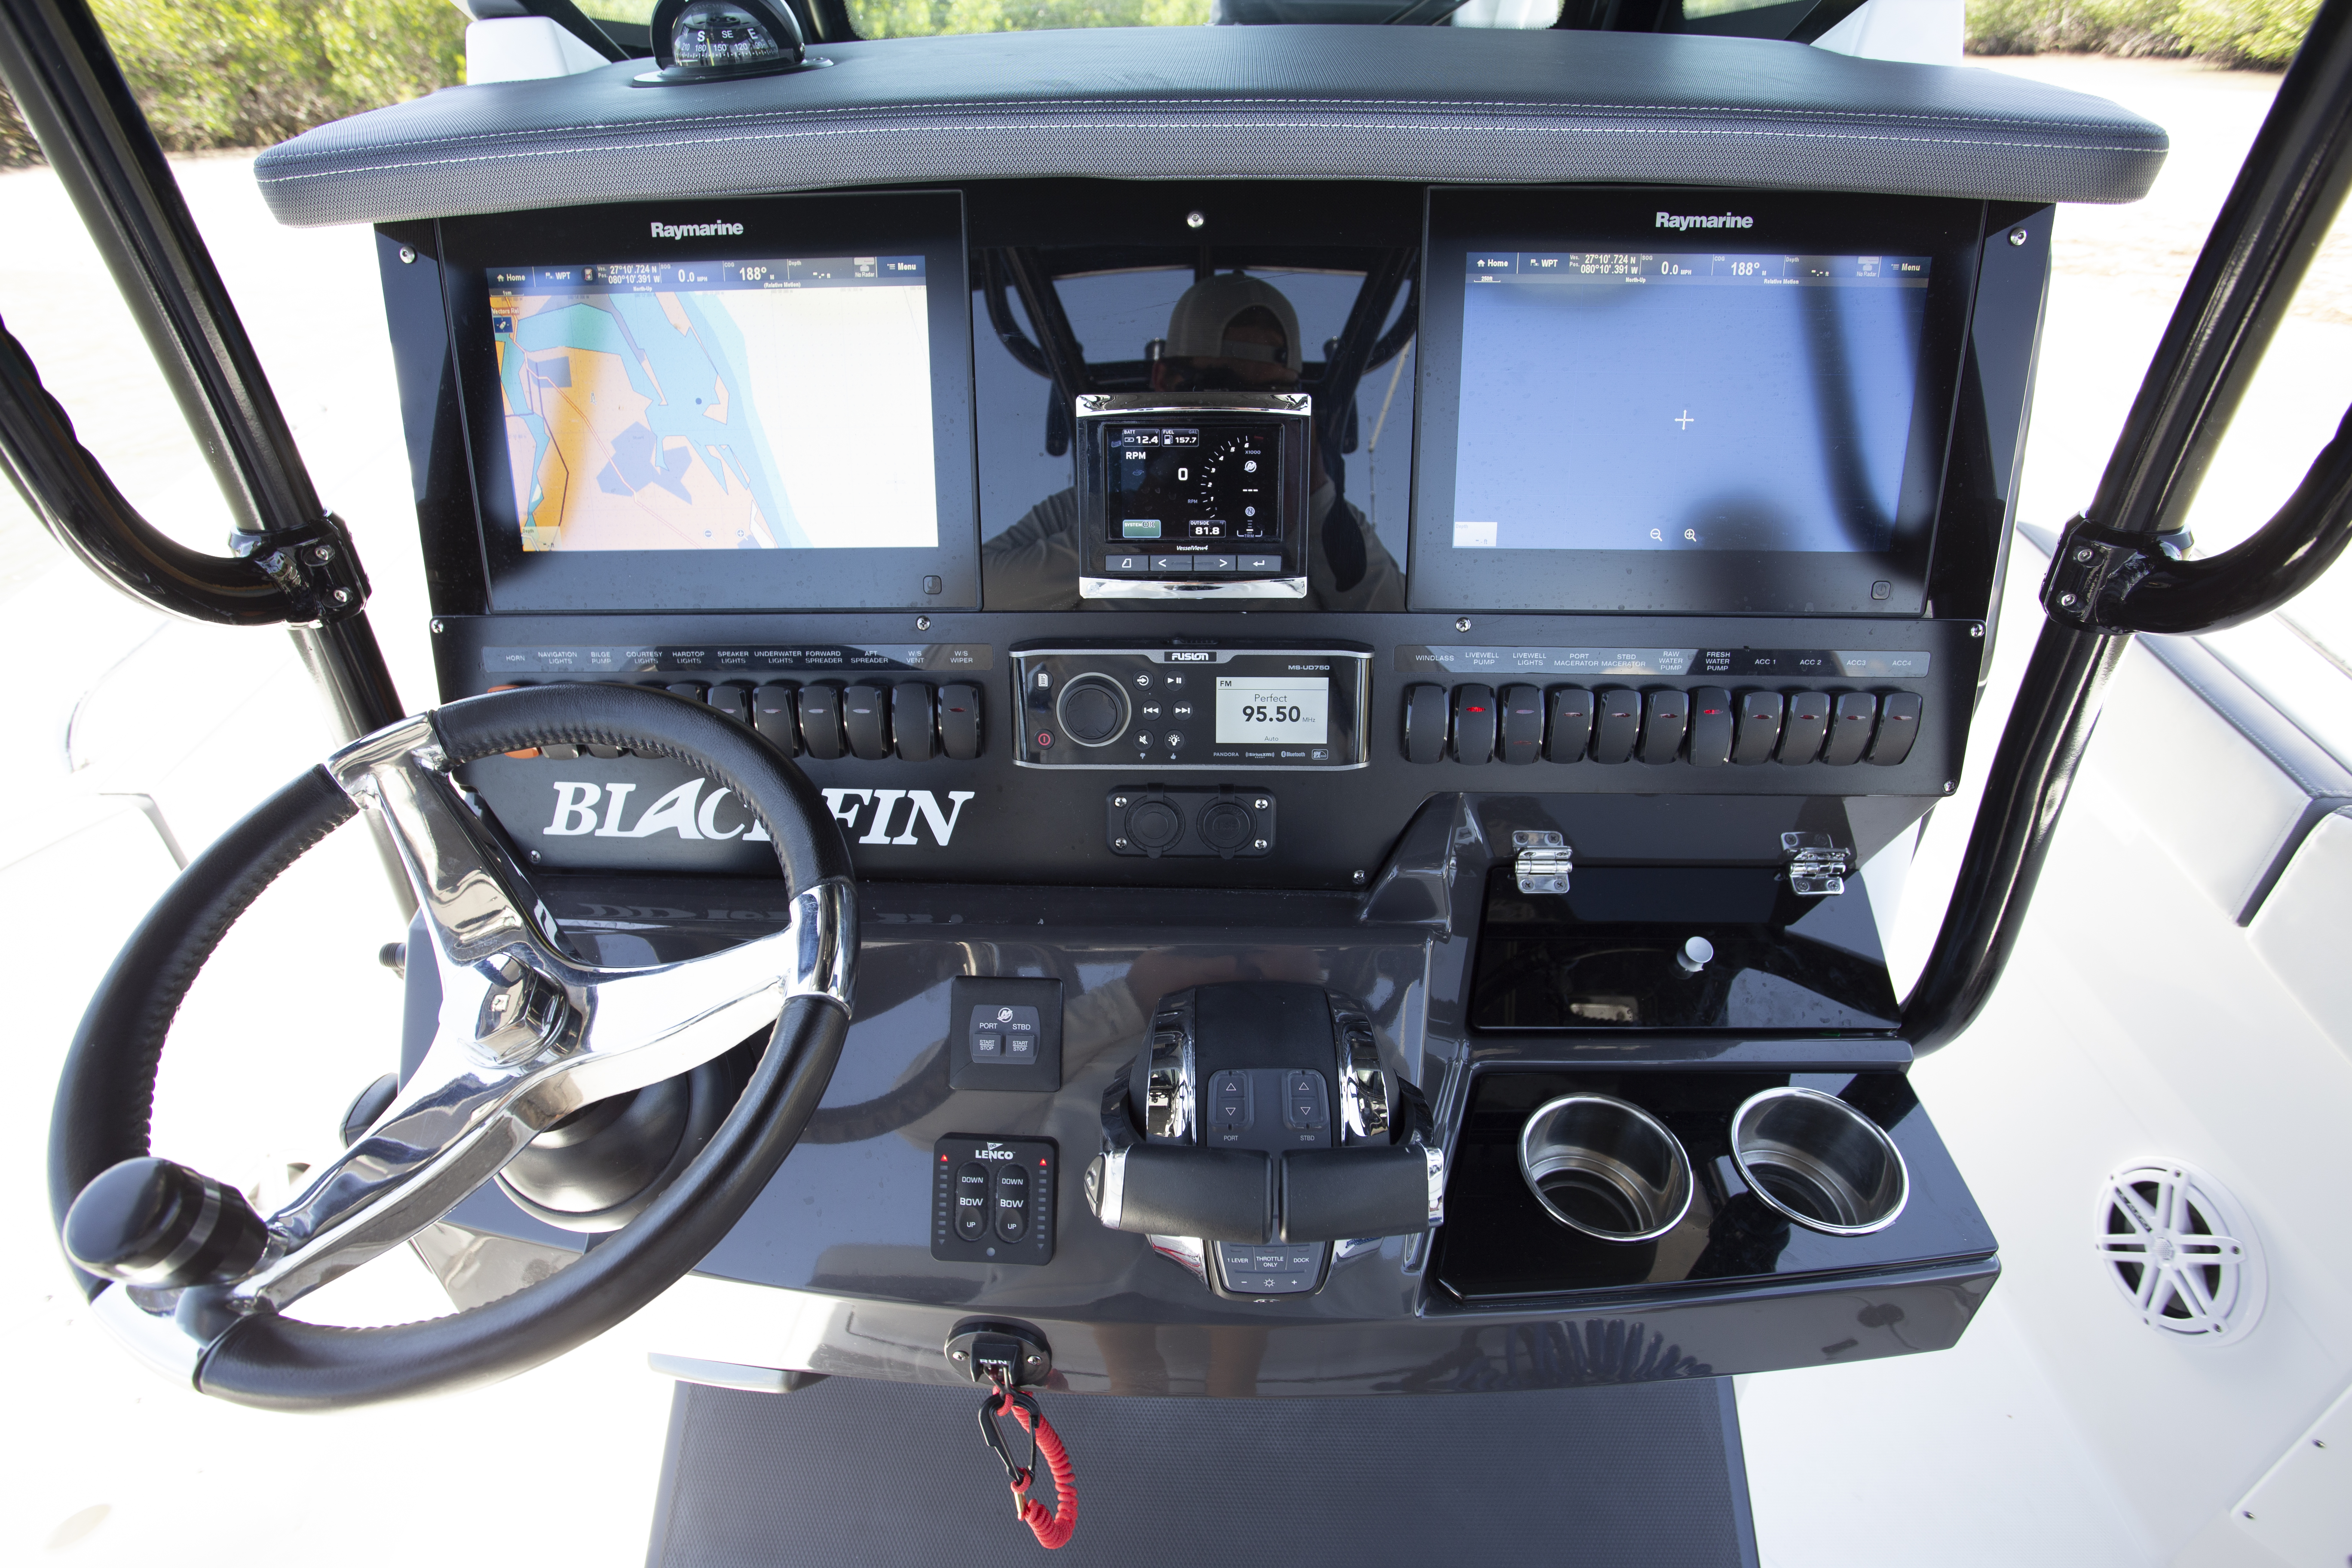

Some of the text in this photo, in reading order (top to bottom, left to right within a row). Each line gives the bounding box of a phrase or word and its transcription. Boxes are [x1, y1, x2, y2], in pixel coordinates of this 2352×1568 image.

[697, 28, 758, 42] S SE E
[1656, 212, 1753, 231] Raymarine
[650, 219, 744, 240] Raymarine
[1488, 259, 1508, 267] Home
[1541, 259, 1558, 267] WPT
[1661, 261, 1678, 275] 0.0
[739, 266, 767, 281] 188°
[1731, 262, 1760, 276] 188°
[506, 273, 525, 282] Home
[555, 272, 571, 280] WPT
[653, 275, 660, 283] W
[678, 269, 695, 282] 0.0
[491, 307, 511, 315] Vectors
[1126, 451, 1146, 459] RPM
[1178, 468, 1188, 481] 0
[1255, 693, 1287, 702] Perfect
[1242, 705, 1301, 722] 95.50
[543, 777, 975, 846] BLACFIN
[975, 1150, 1014, 1160] LENCO
[960, 1197, 983, 1206] BOW
[1000, 1199, 1024, 1207] BOW
